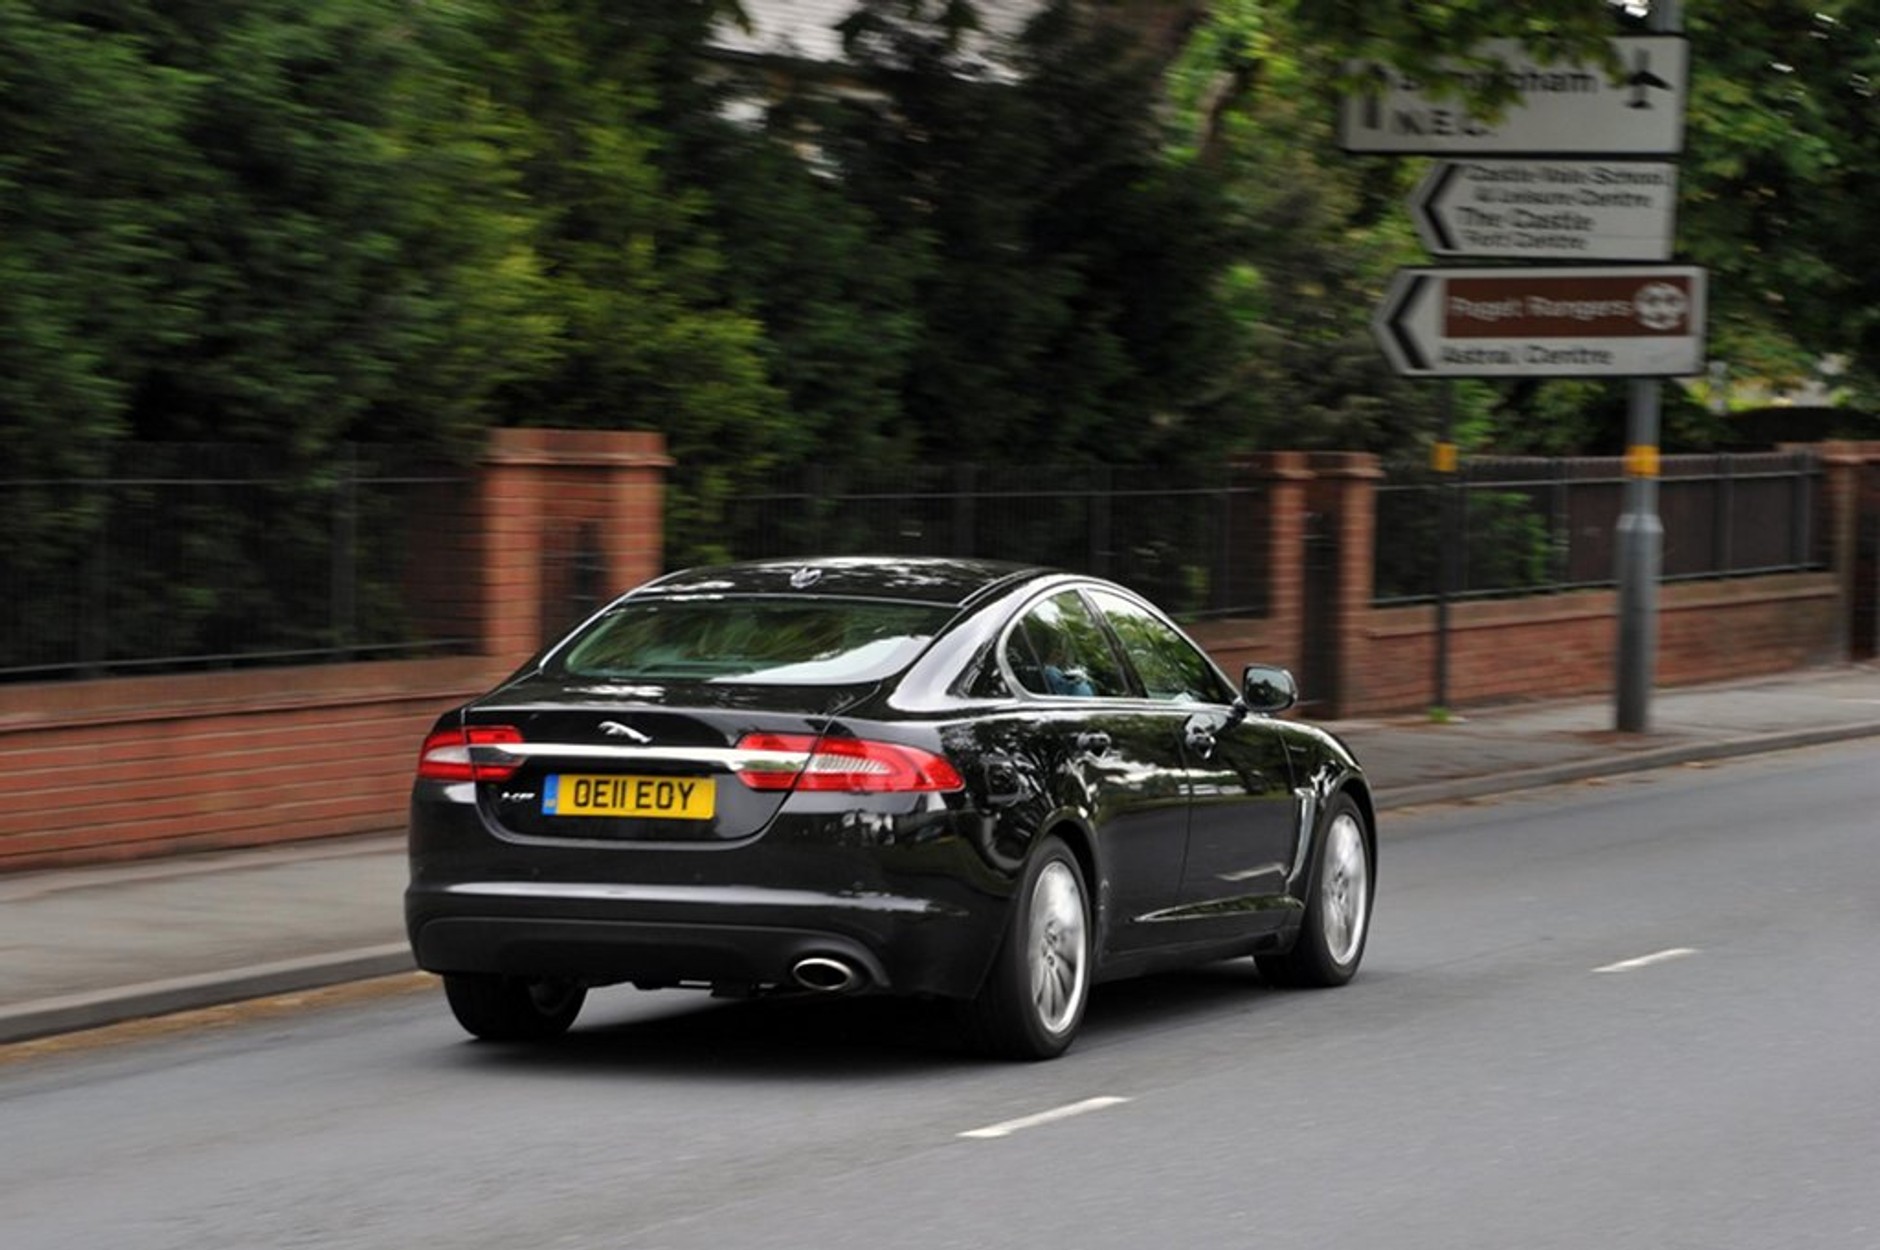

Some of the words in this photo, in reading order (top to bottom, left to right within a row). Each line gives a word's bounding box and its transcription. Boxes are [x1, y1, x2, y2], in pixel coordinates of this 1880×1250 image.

[1457, 206, 1504, 229] The
[1508, 208, 1596, 232] Castle
[1526, 296, 1634, 321] Rangers
[1524, 344, 1614, 366] Centre
[573, 778, 626, 808] OE11
[635, 779, 696, 811] EOY
